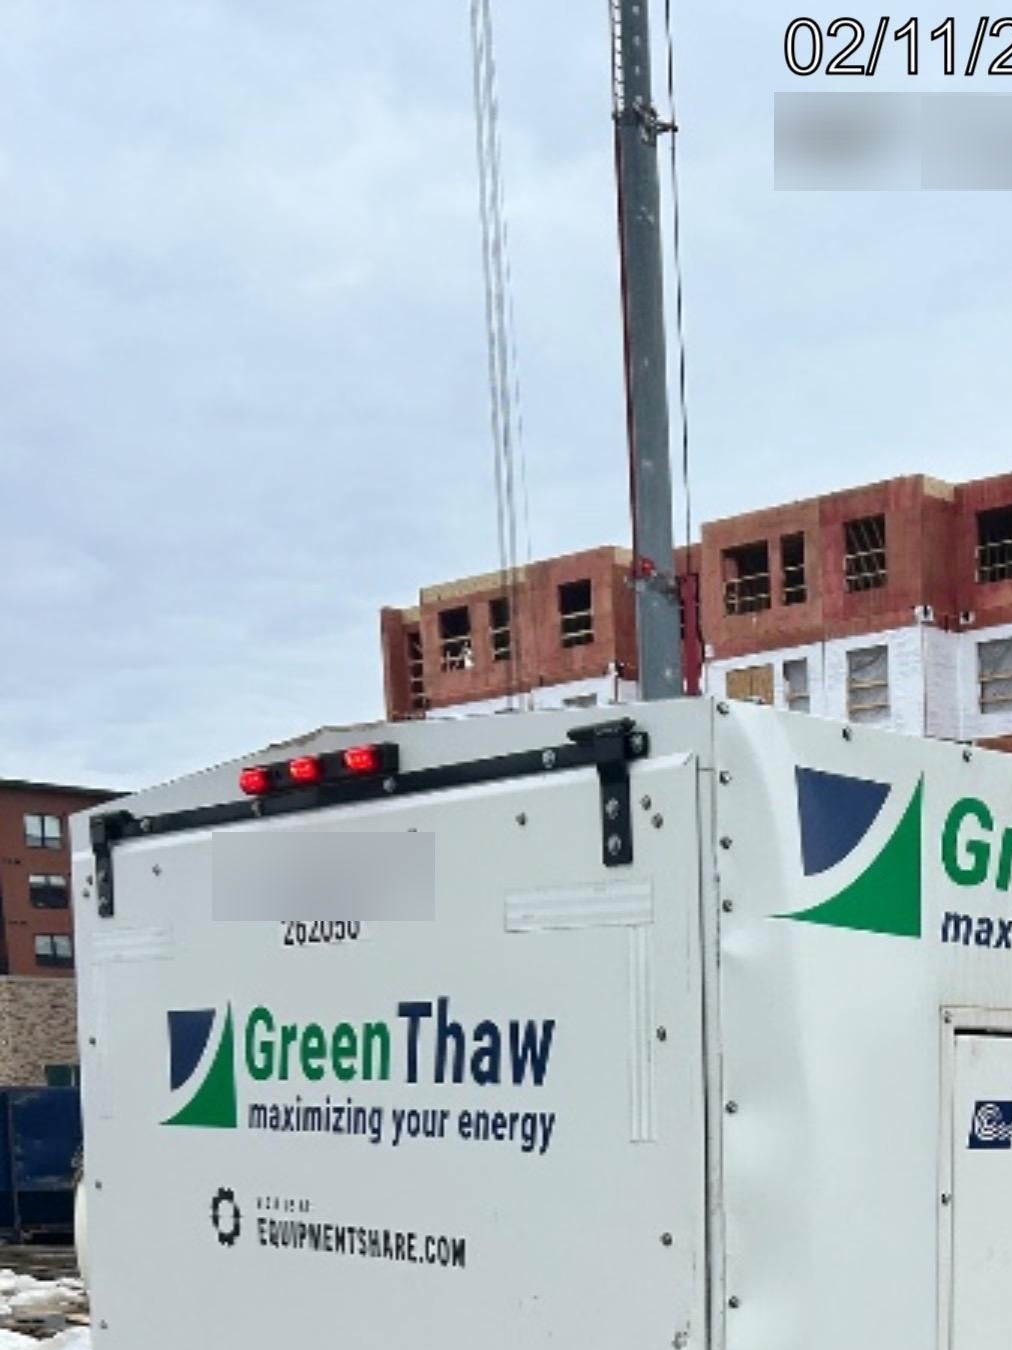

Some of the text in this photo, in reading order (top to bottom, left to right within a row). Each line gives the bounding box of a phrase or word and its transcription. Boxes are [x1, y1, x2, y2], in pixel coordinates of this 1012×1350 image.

[247, 1094, 557, 1156] maximizing your energy
[256, 1217, 467, 1269] EQUIPMENTSHARE.COM
